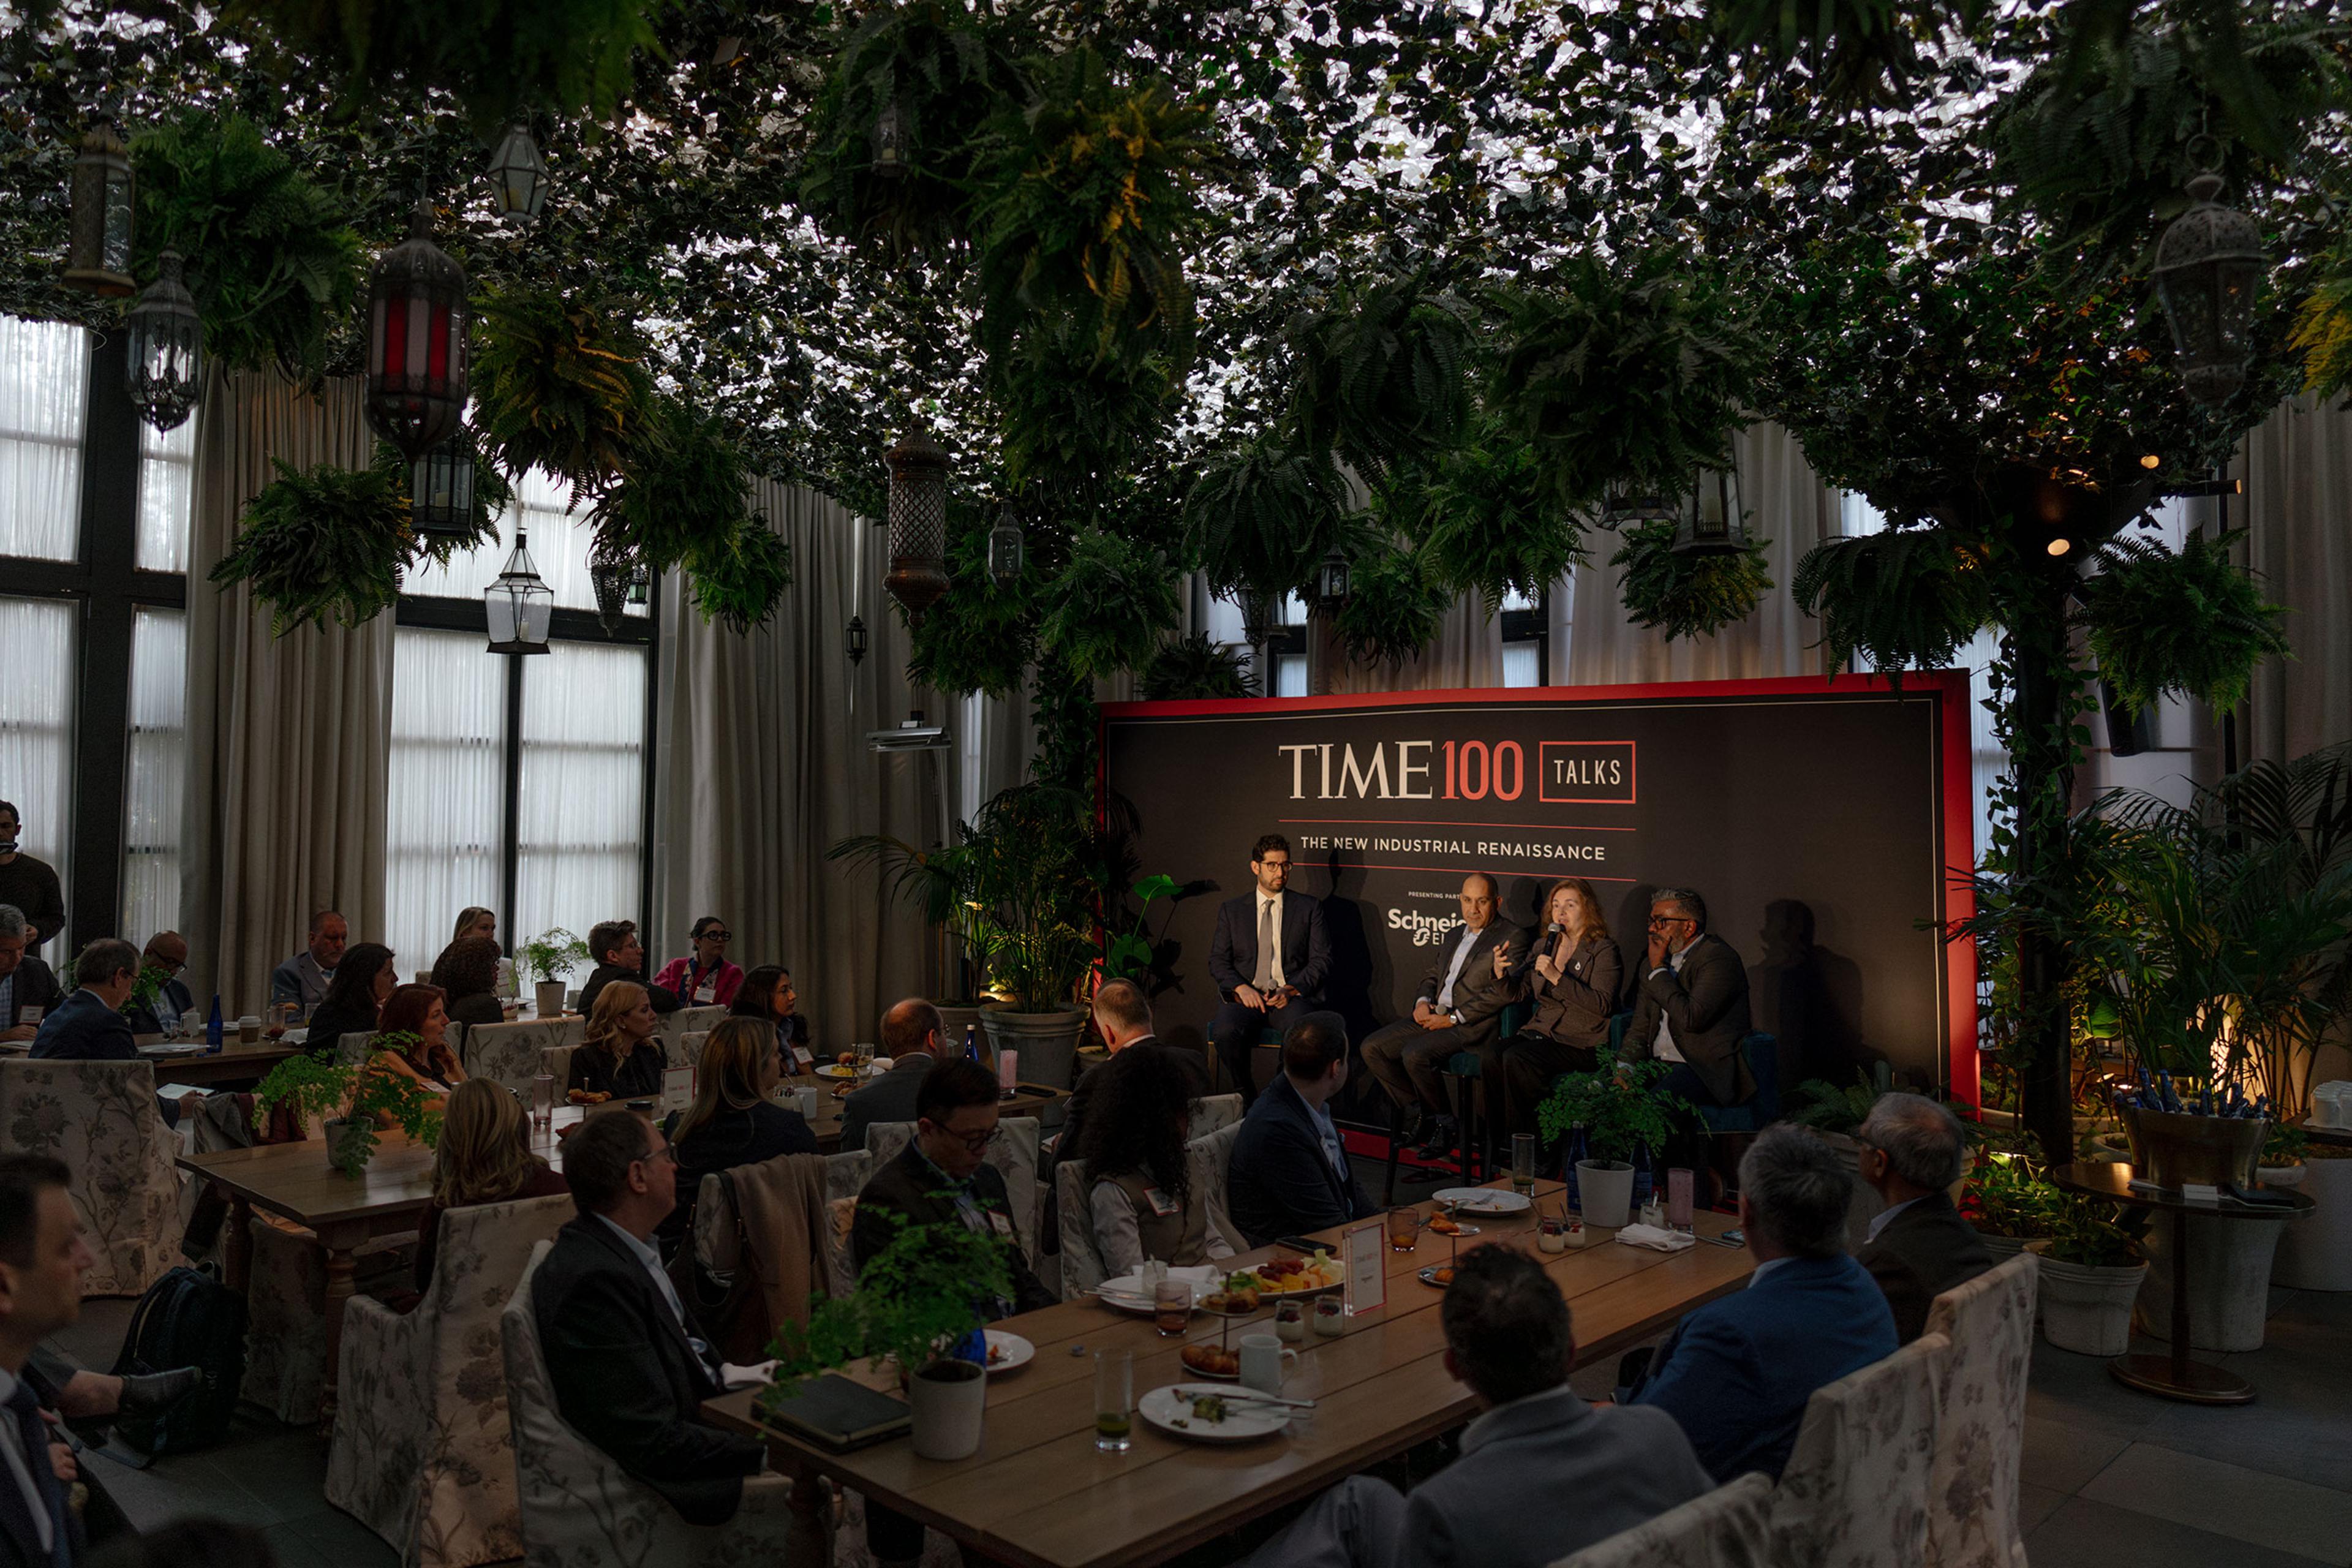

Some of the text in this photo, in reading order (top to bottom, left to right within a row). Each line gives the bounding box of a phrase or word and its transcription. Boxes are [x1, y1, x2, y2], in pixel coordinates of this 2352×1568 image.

[1553, 760, 1621, 785] TALKS
[1301, 837, 1605, 861] THE NEW INDUSTRIAL RENAISSANCE
[1388, 908, 1467, 933] Schnei
